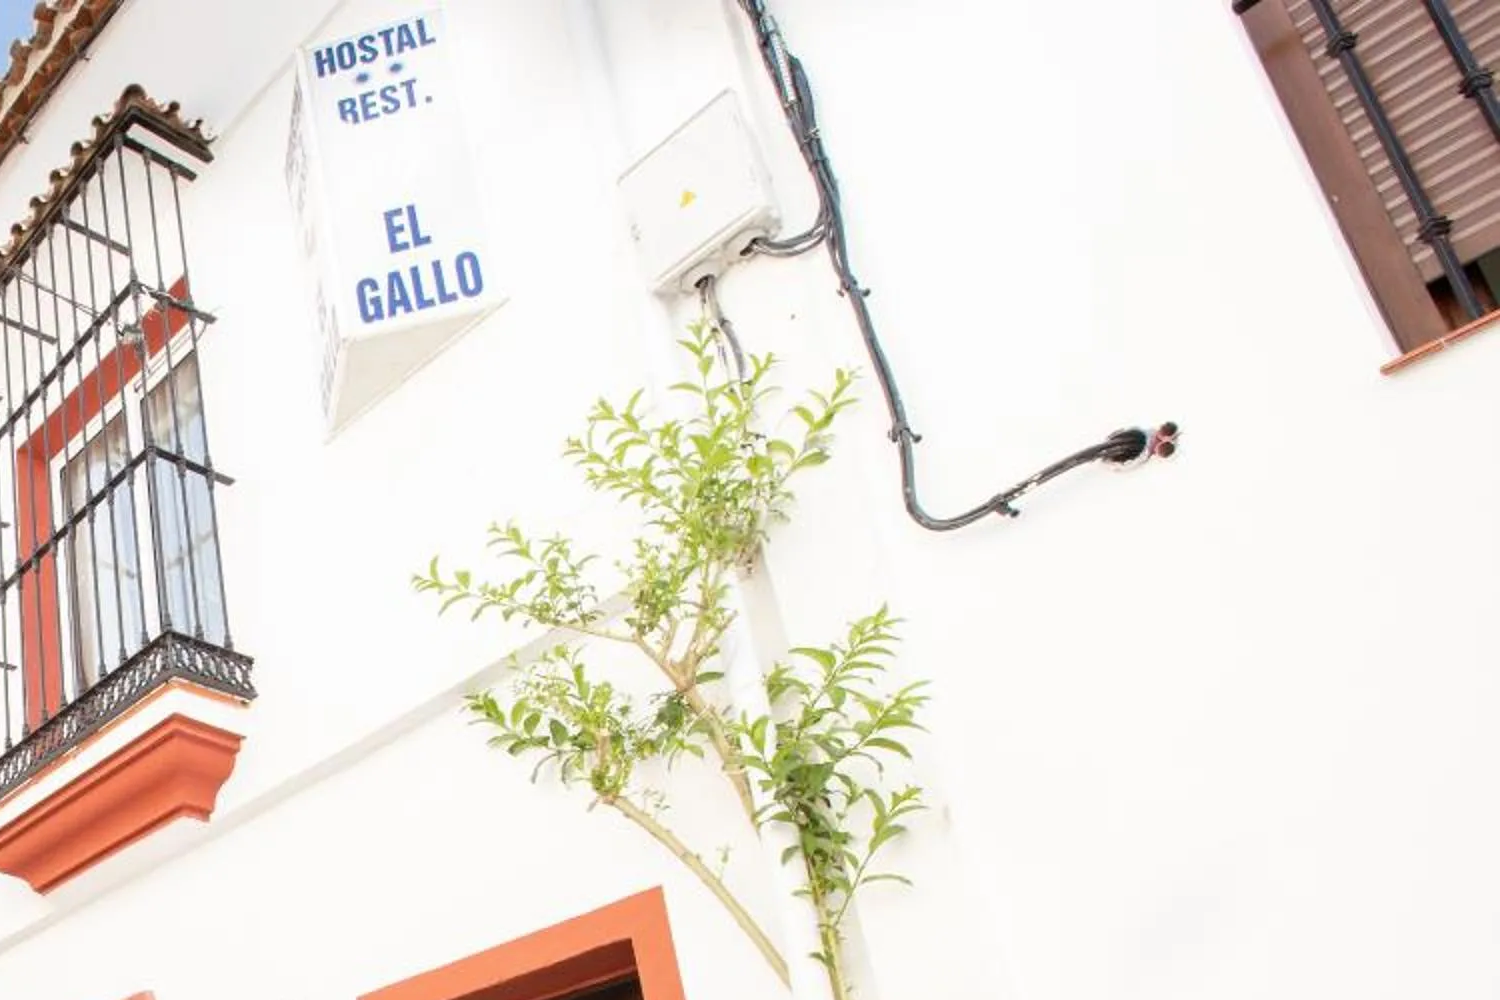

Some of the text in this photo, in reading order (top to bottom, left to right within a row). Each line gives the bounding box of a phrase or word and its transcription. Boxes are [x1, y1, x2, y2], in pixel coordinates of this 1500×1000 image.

[314, 17, 436, 78] HOSTAL
[337, 78, 433, 125] REST.
[383, 203, 432, 254] EL
[355, 250, 485, 324] GALLO
